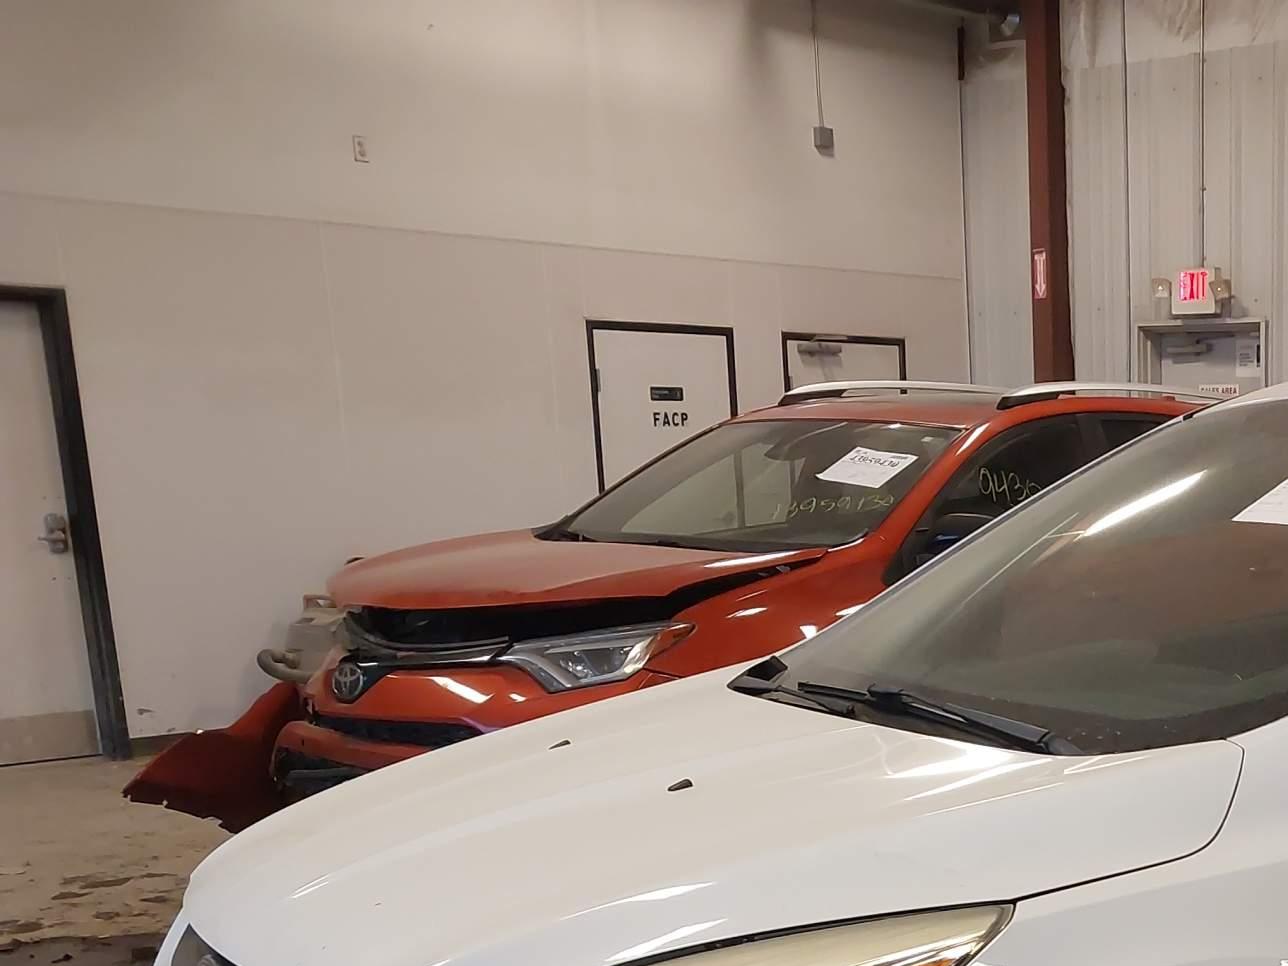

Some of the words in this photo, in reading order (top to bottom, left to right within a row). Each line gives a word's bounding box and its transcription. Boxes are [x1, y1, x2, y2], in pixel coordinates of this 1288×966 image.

[1179, 271, 1207, 301] EXIT
[1221, 386, 1237, 394] AREA
[653, 411, 688, 427] FACP
